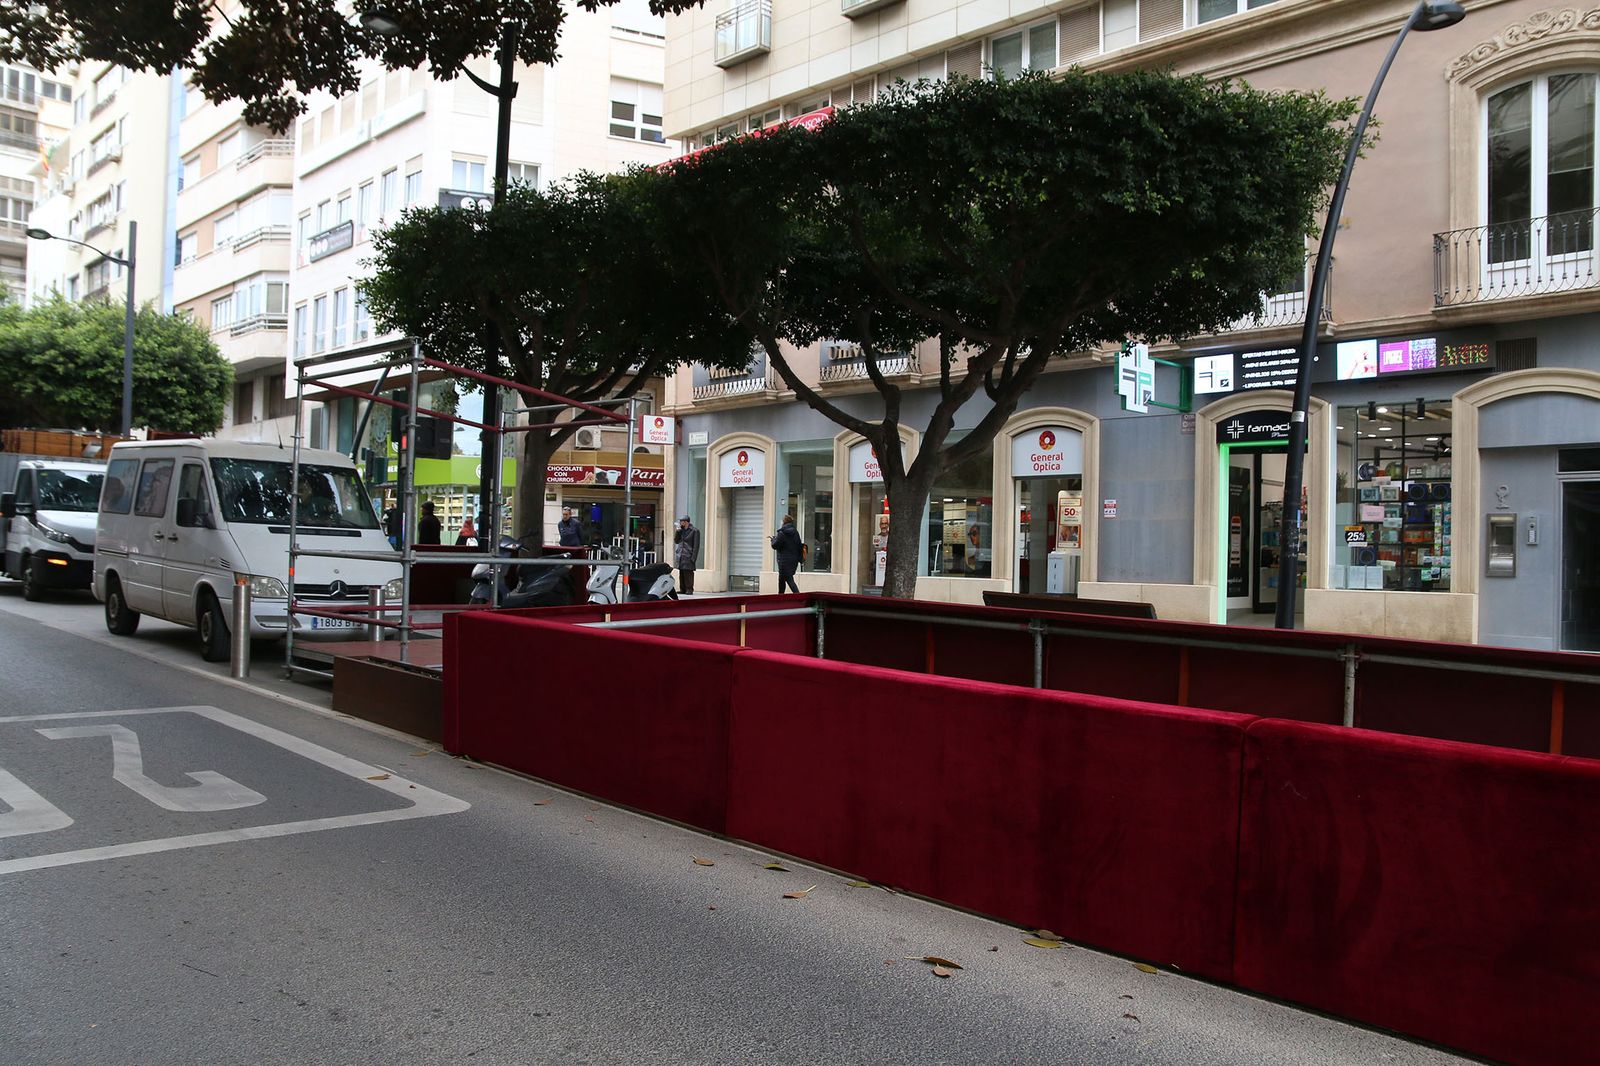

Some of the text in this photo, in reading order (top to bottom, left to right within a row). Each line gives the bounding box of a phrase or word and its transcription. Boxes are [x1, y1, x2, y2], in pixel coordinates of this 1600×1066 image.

[1247, 422, 1291, 433] farmaci
[1030, 452, 1063, 462] General
[1033, 462, 1061, 473] Optica
[631, 468, 664, 480] Parr
[866, 470, 881, 479] Opti
[733, 476, 752, 484] Optica
[320, 618, 342, 627] 1803
